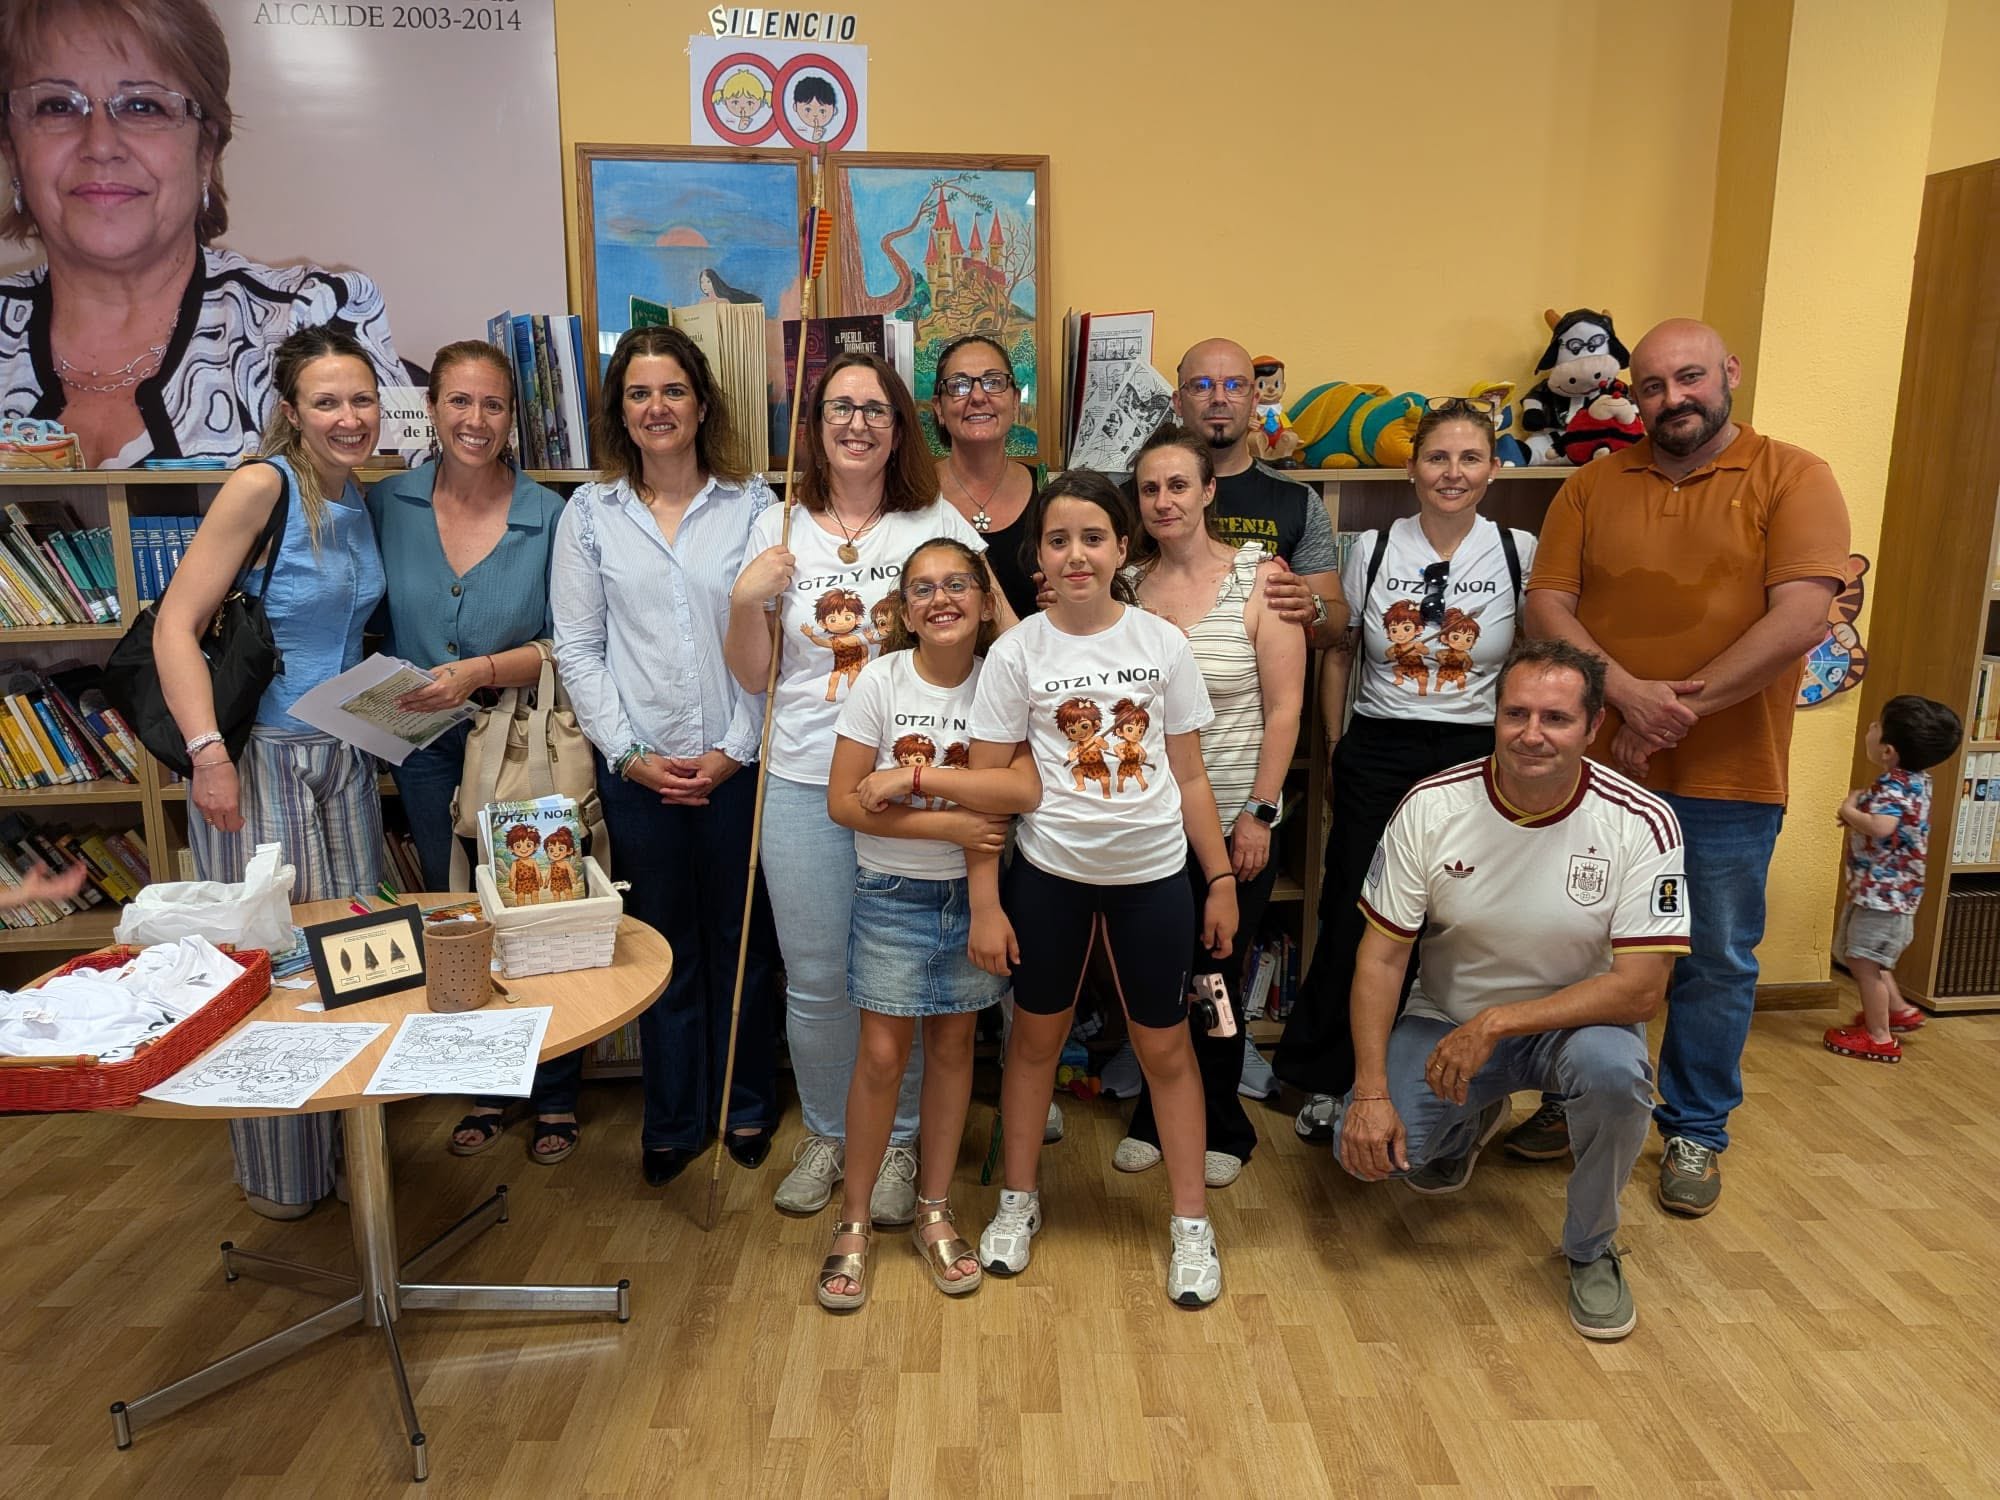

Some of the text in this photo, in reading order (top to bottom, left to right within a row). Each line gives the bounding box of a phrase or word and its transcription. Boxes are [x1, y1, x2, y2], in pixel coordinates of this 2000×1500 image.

[253, 3, 522, 31] ALCALDE 2003-2014
[711, 8, 856, 40] SILENCIO
[403, 425, 420, 438] de
[797, 565, 902, 590] OTZI Y NO
[1386, 577, 1429, 595] OTZI
[1454, 580, 1496, 595] NOA
[1044, 668, 1160, 692] OTZI Y NOA
[894, 713, 935, 727] OTZI
[941, 716, 949, 729] Y
[498, 808, 572, 824] OTZI Y NOA
